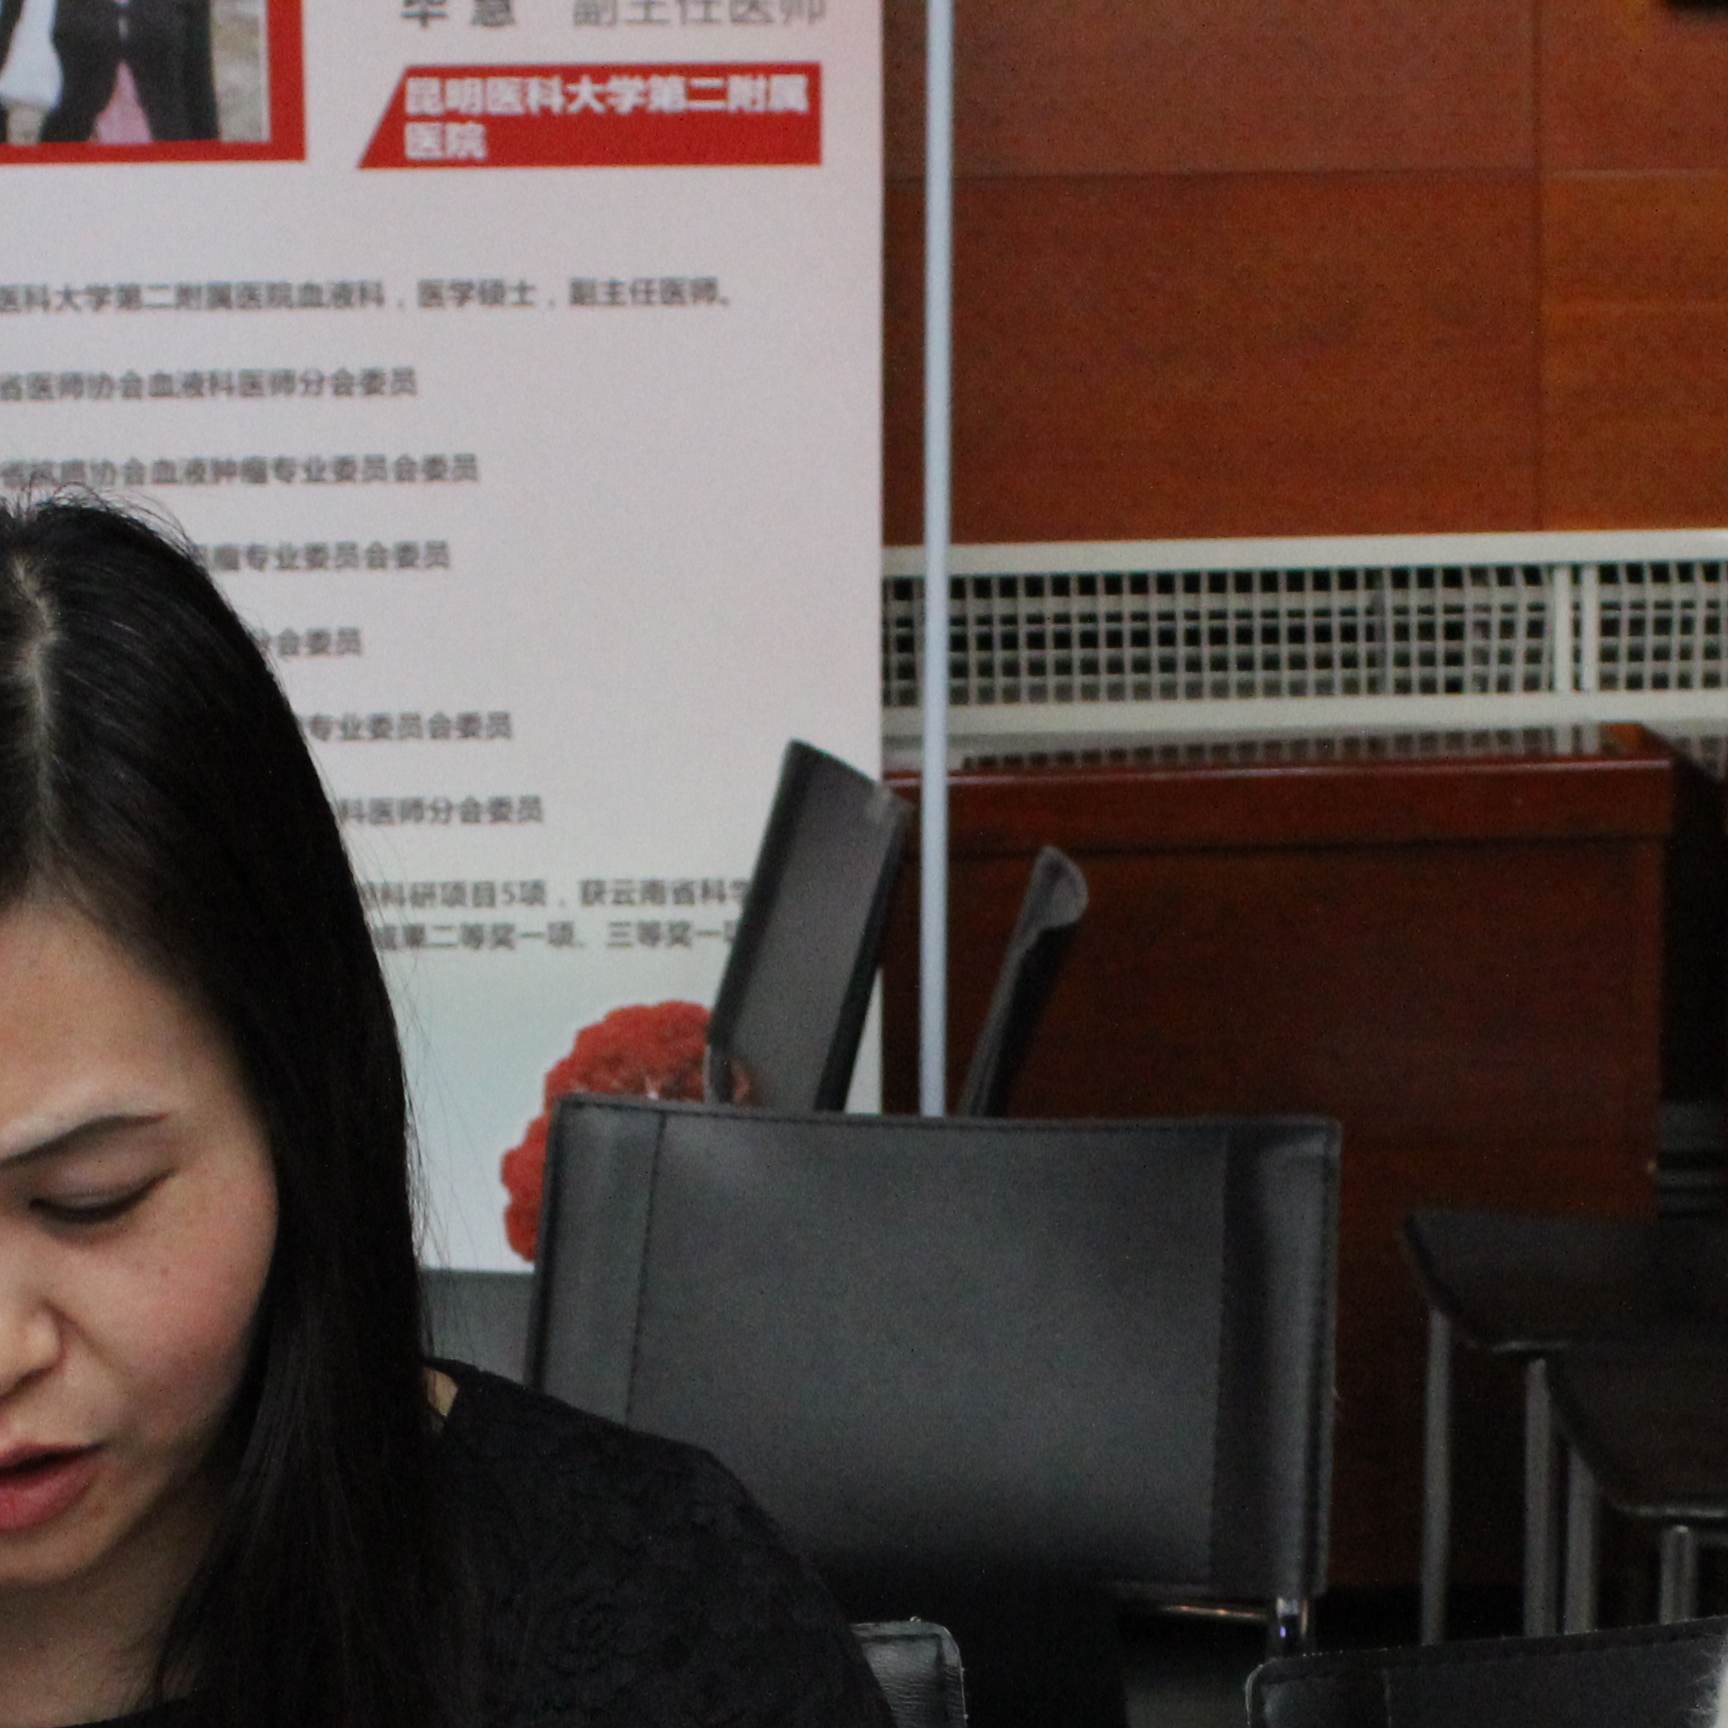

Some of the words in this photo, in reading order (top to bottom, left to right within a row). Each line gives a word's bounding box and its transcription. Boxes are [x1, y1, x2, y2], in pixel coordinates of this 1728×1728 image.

[405, 74, 808, 116] 昆明医科大学第二附属
[404, 121, 486, 160] 医院
[300, 712, 513, 741] 专业委员会委员
